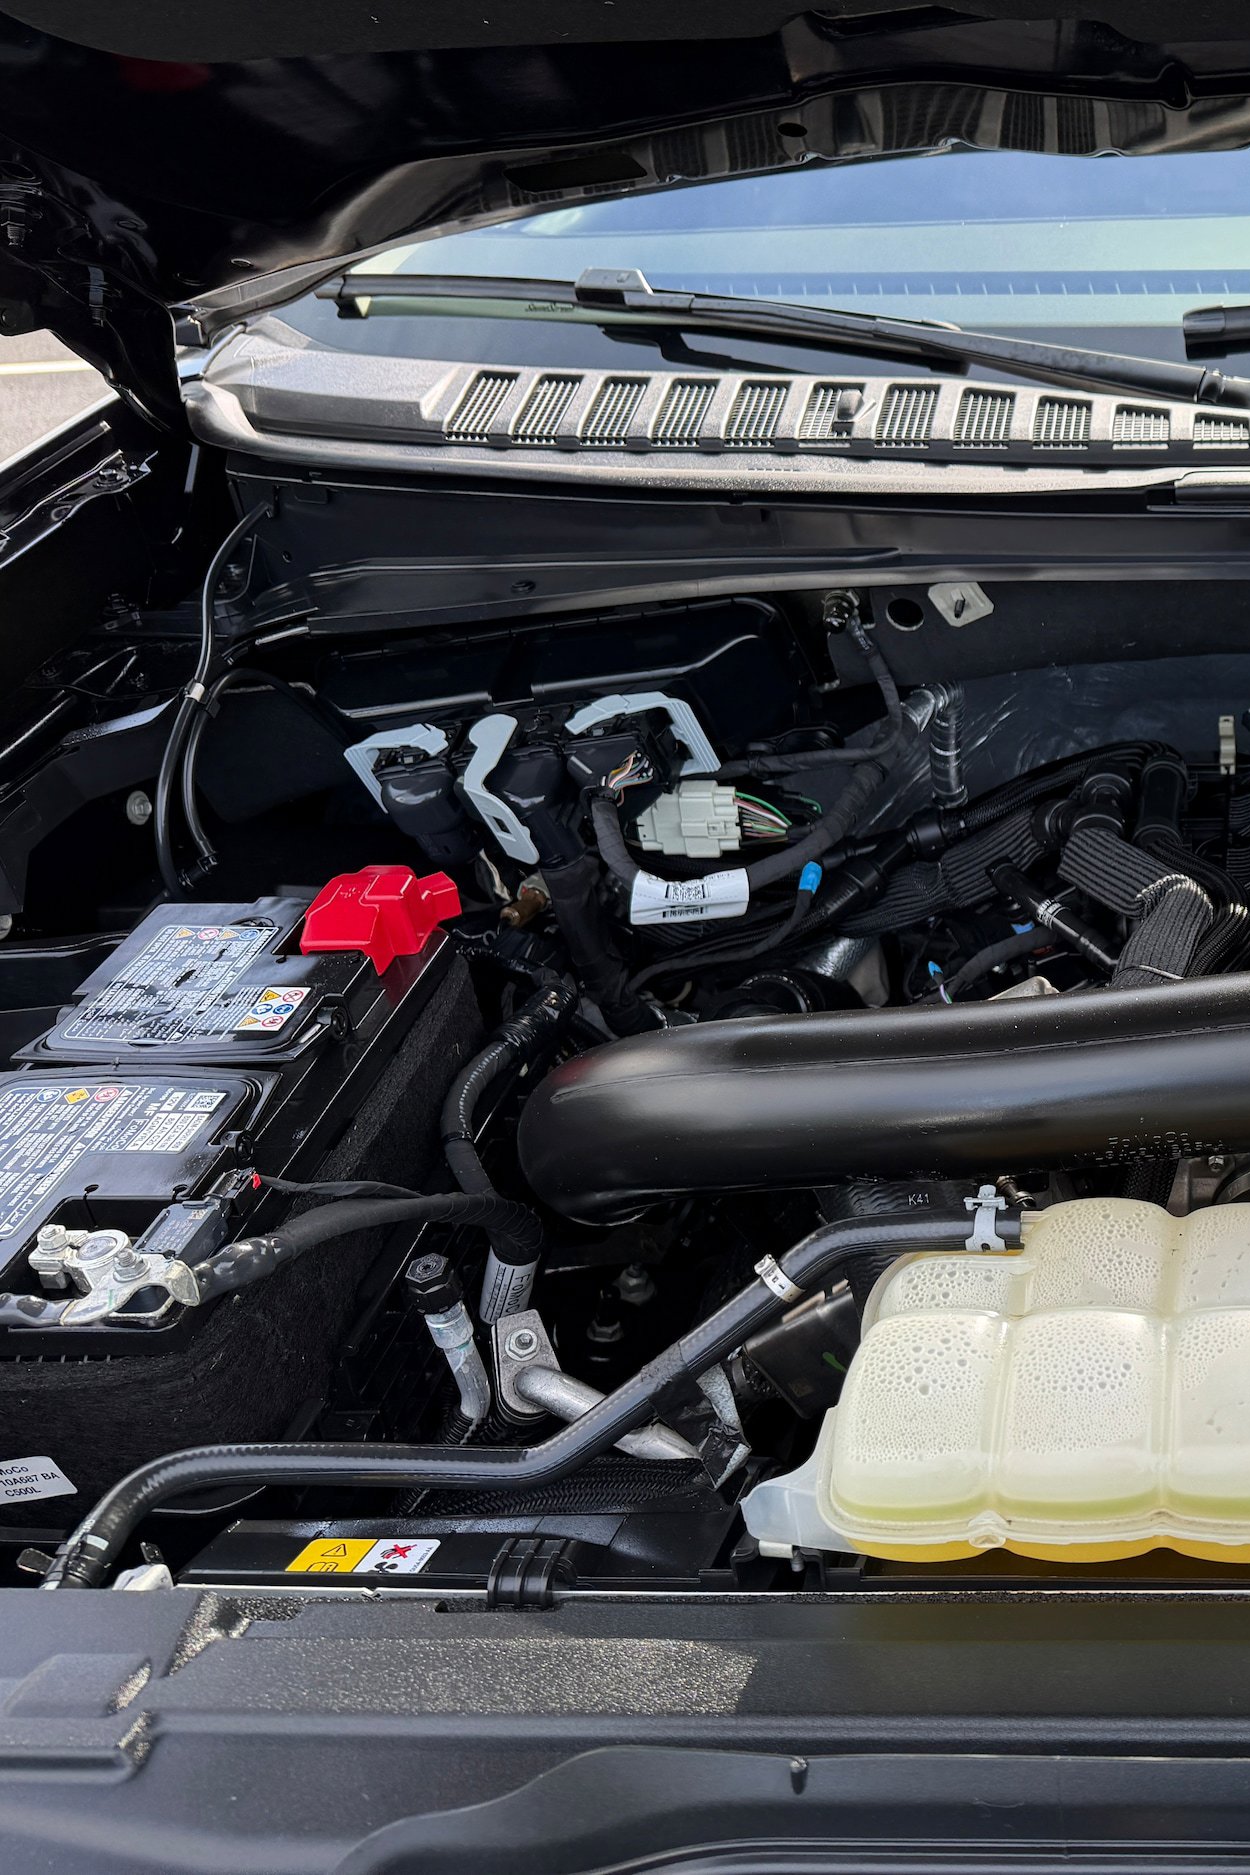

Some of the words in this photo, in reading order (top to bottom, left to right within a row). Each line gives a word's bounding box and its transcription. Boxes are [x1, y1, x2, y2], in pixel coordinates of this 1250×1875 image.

[505, 1273, 531, 1313] FoMoC
[41, 1472, 61, 1480] BA
[5, 1486, 42, 1497] C500L
